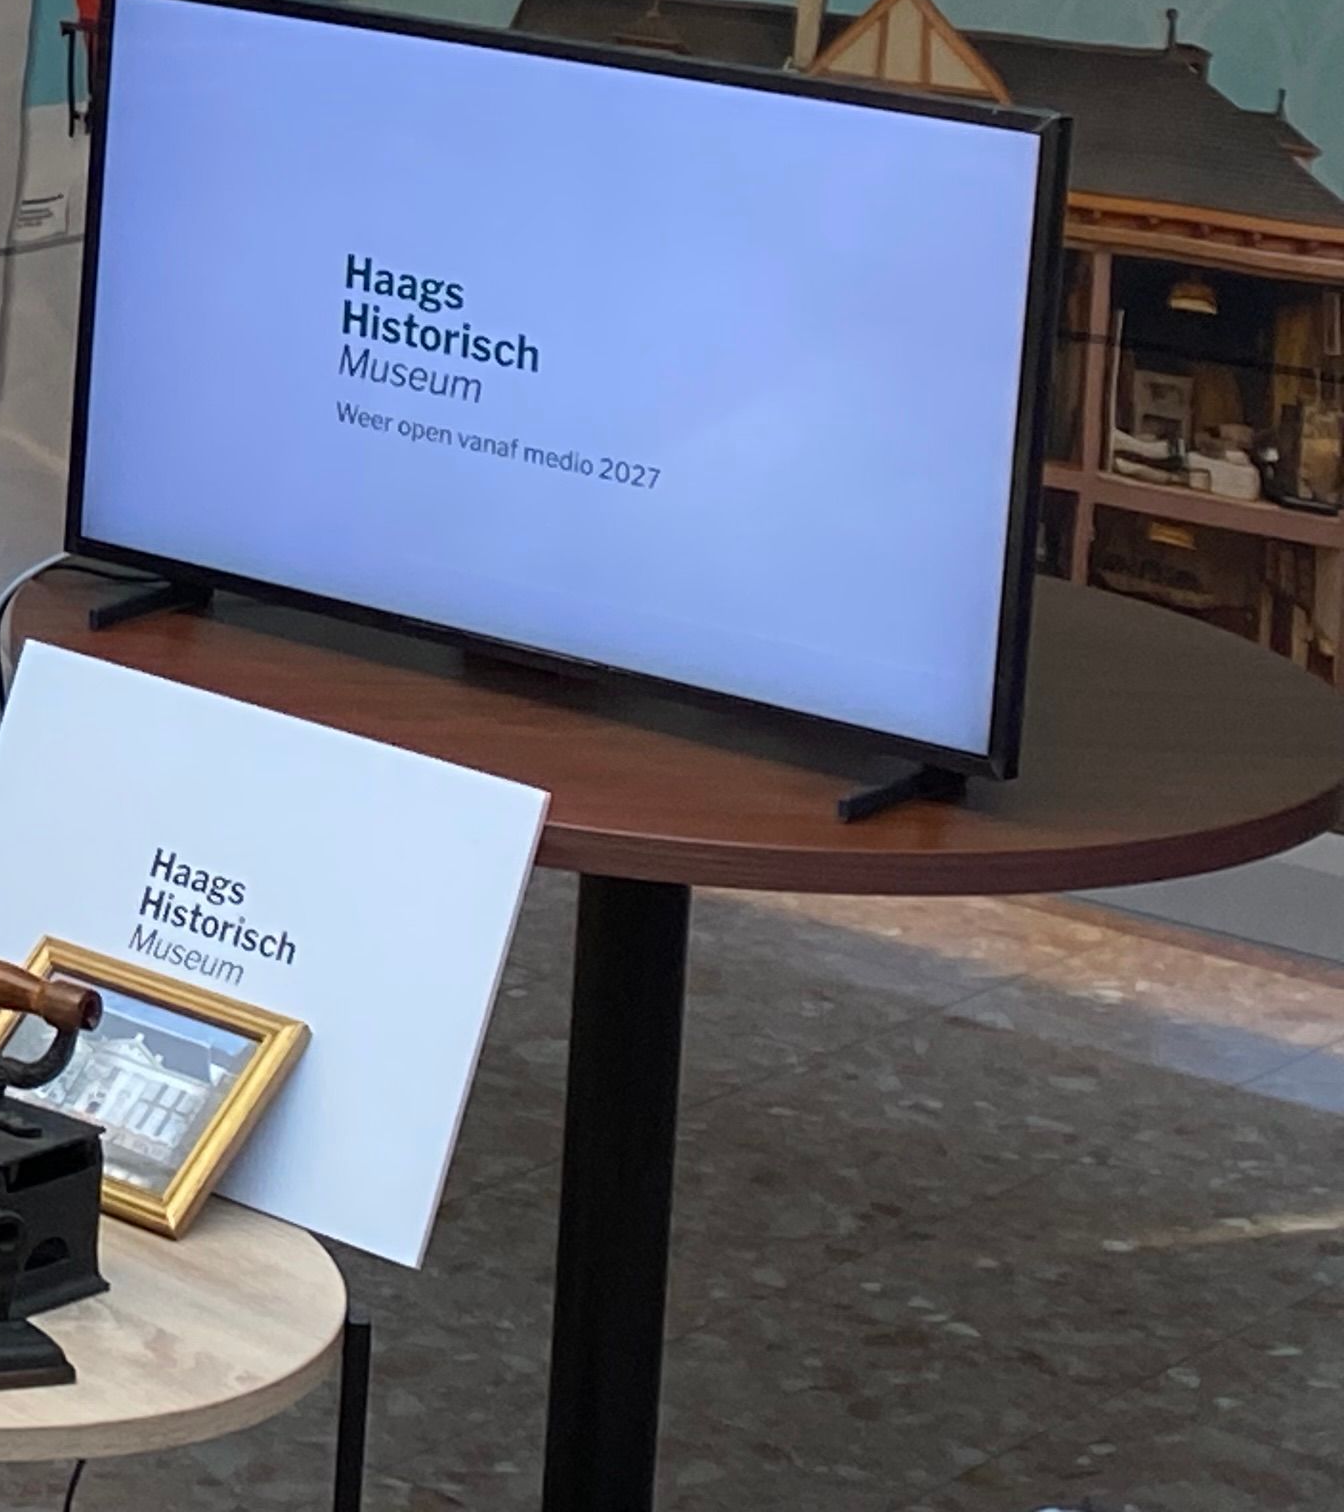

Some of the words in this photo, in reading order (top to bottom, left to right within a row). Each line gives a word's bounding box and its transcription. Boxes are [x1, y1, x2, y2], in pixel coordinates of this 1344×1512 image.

[344, 253, 465, 313] Haags
[341, 299, 540, 373] Historisch
[338, 344, 483, 404] Museum
[336, 400, 393, 433] Weer
[397, 416, 453, 445] open
[458, 431, 520, 459] vanaf
[523, 444, 595, 476] medio
[598, 457, 662, 489] 2027
[150, 847, 247, 906] Haags
[128, 923, 245, 986] Museum
[139, 886, 296, 965] Historisch
